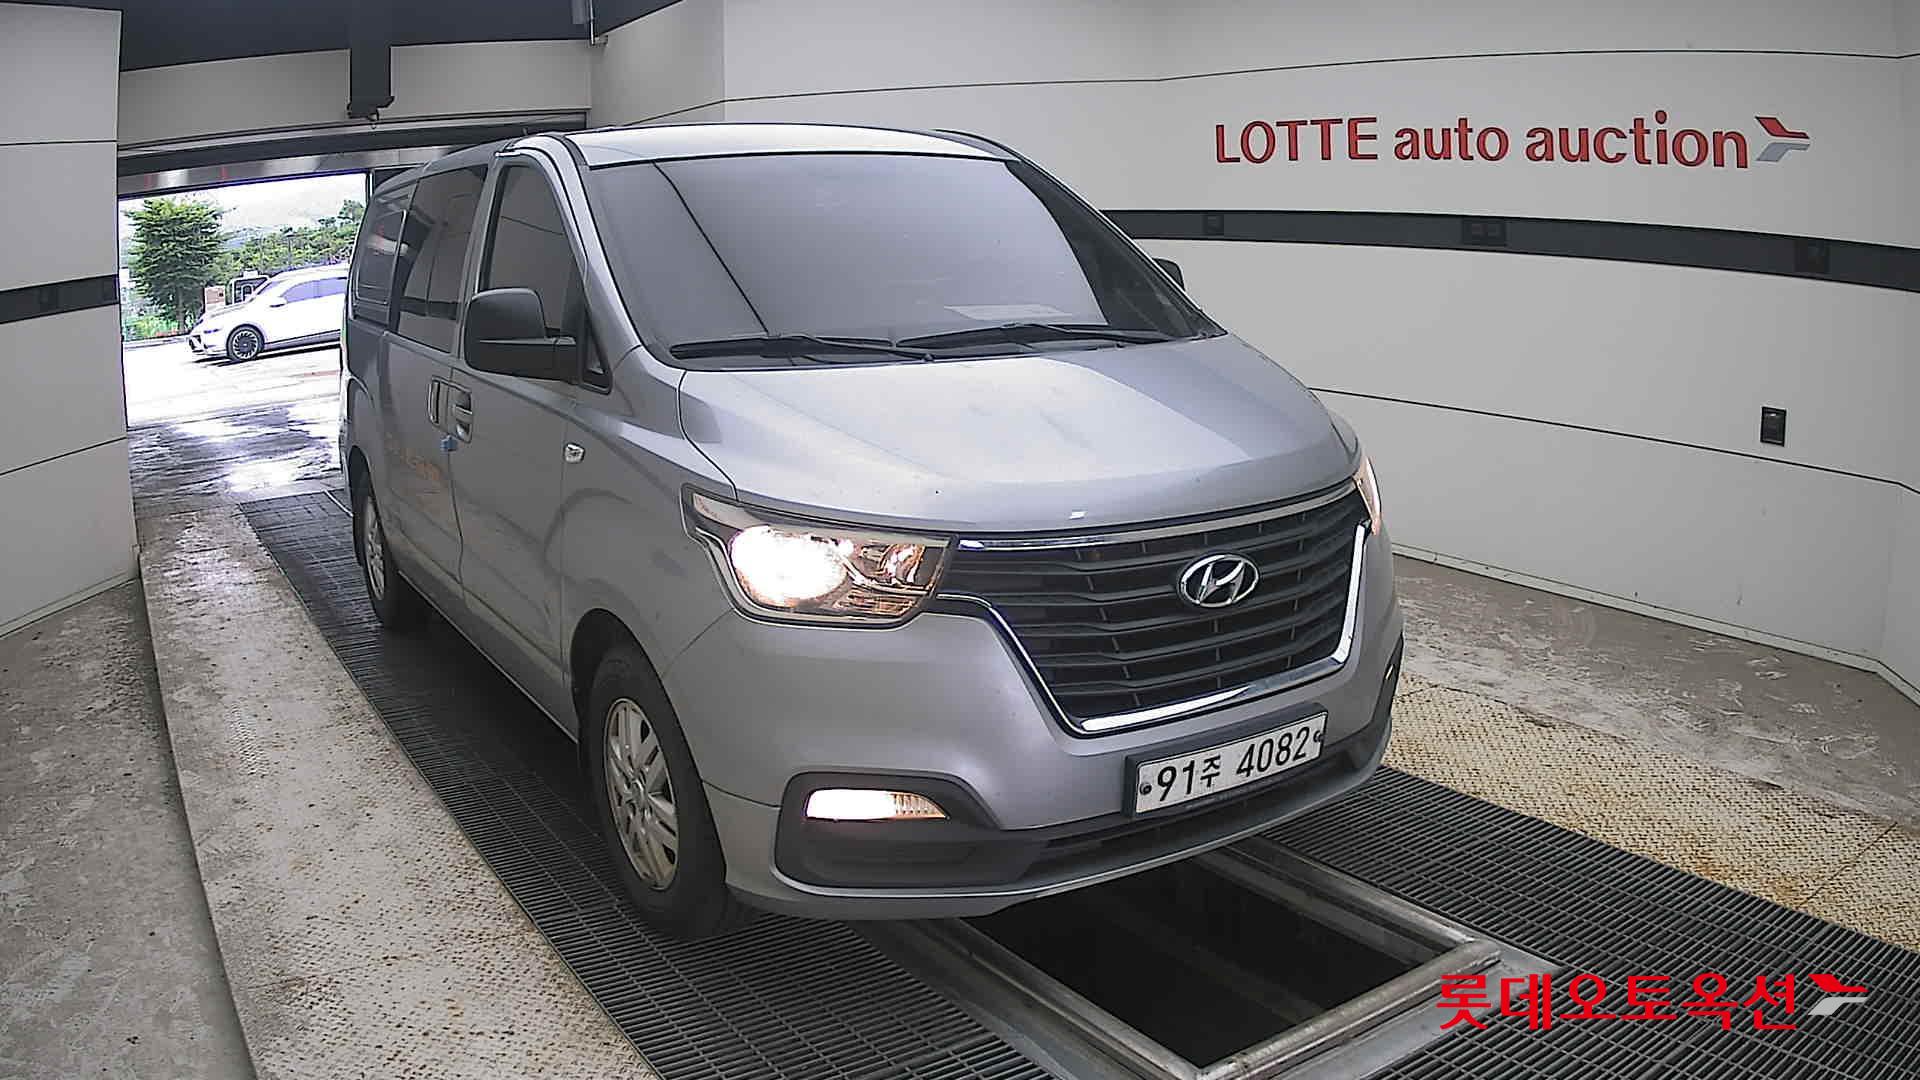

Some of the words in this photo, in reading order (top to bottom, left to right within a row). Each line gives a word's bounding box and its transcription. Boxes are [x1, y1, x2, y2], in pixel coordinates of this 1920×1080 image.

[1215, 117, 1379, 164] LOTTE
[1394, 117, 1510, 162] auto
[1525, 110, 1750, 169] auction
[1157, 755, 1221, 802] 91주
[1236, 726, 1311, 777] 4082
